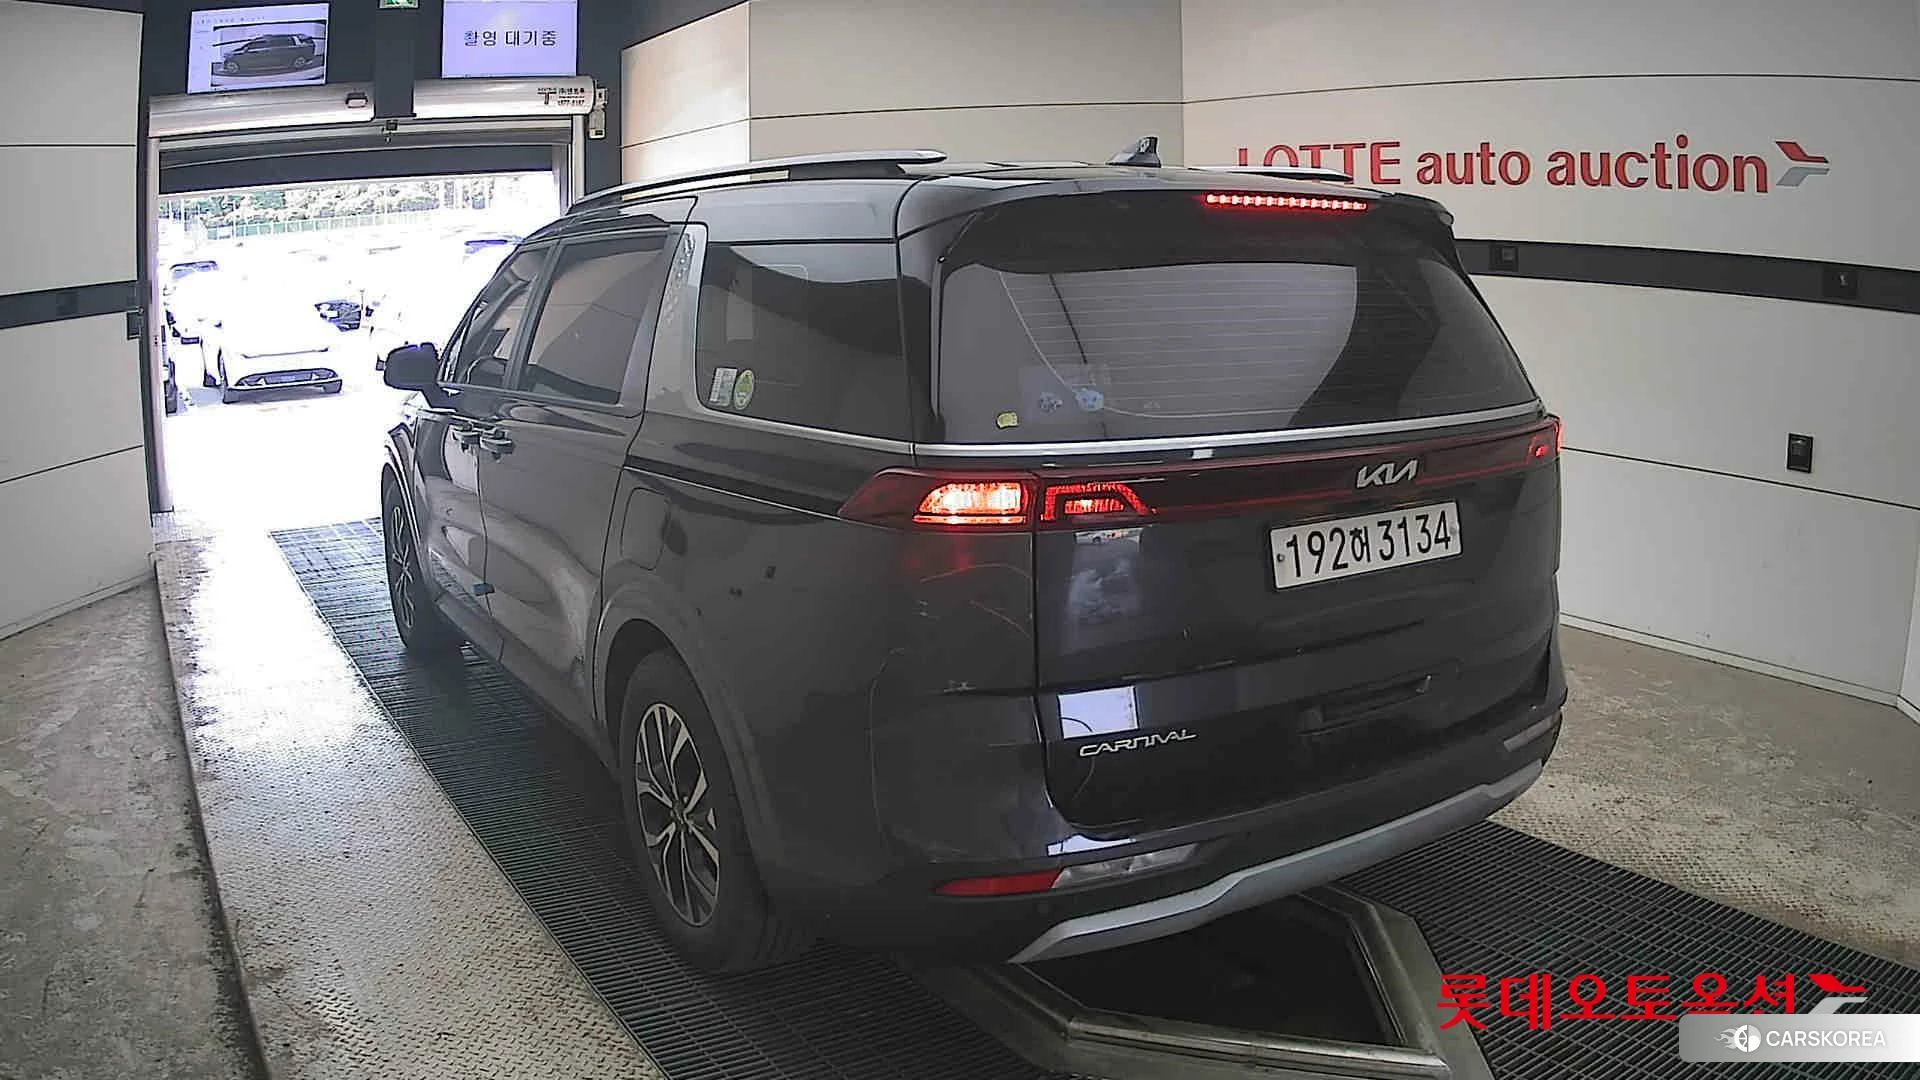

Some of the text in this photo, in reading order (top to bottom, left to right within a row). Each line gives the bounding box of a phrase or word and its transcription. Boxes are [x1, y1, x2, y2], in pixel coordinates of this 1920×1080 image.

[505, 30, 557, 47] 대기중
[1416, 143, 1530, 186] auto
[1547, 135, 1769, 193] auction
[1356, 459, 1418, 488] KIA
[1079, 729, 1197, 757] CARNIVAL
